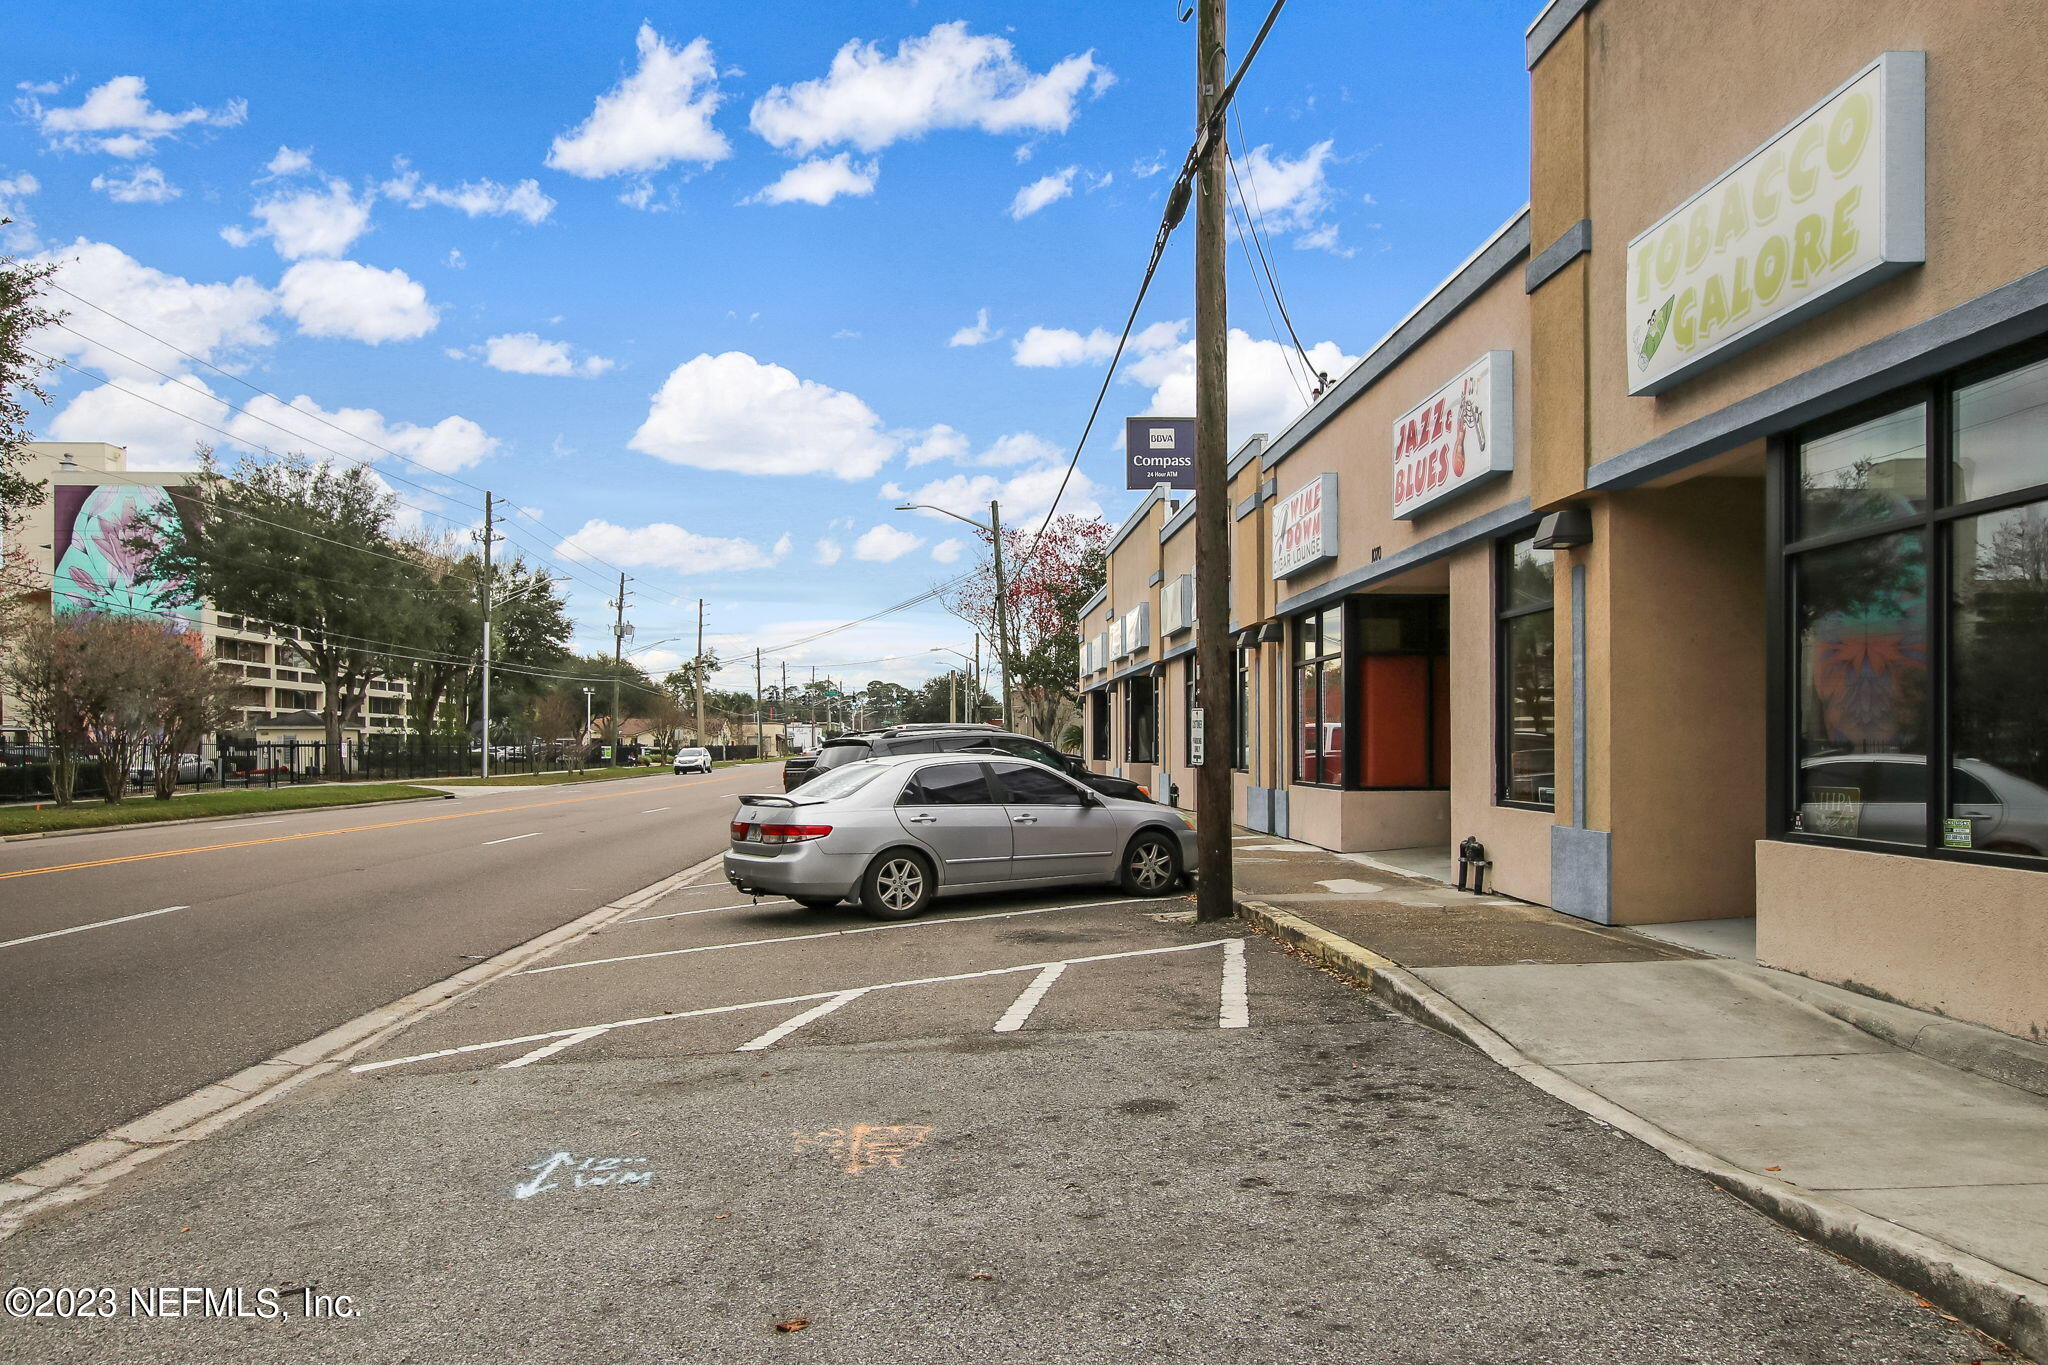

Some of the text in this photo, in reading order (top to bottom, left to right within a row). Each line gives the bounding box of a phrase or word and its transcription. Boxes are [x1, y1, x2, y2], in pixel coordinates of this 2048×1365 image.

[1635, 92, 1873, 304] TOBACCO
[1673, 186, 1863, 352] GALORE
[1151, 434, 1174, 443] BBVA
[1395, 397, 1445, 465] JAZZ
[1133, 455, 1191, 468] Compass
[1395, 444, 1449, 507] BLUES
[1290, 484, 1321, 521] WINE
[1286, 512, 1321, 552] DOWN
[1274, 537, 1321, 574] CGAR LOUNGE
